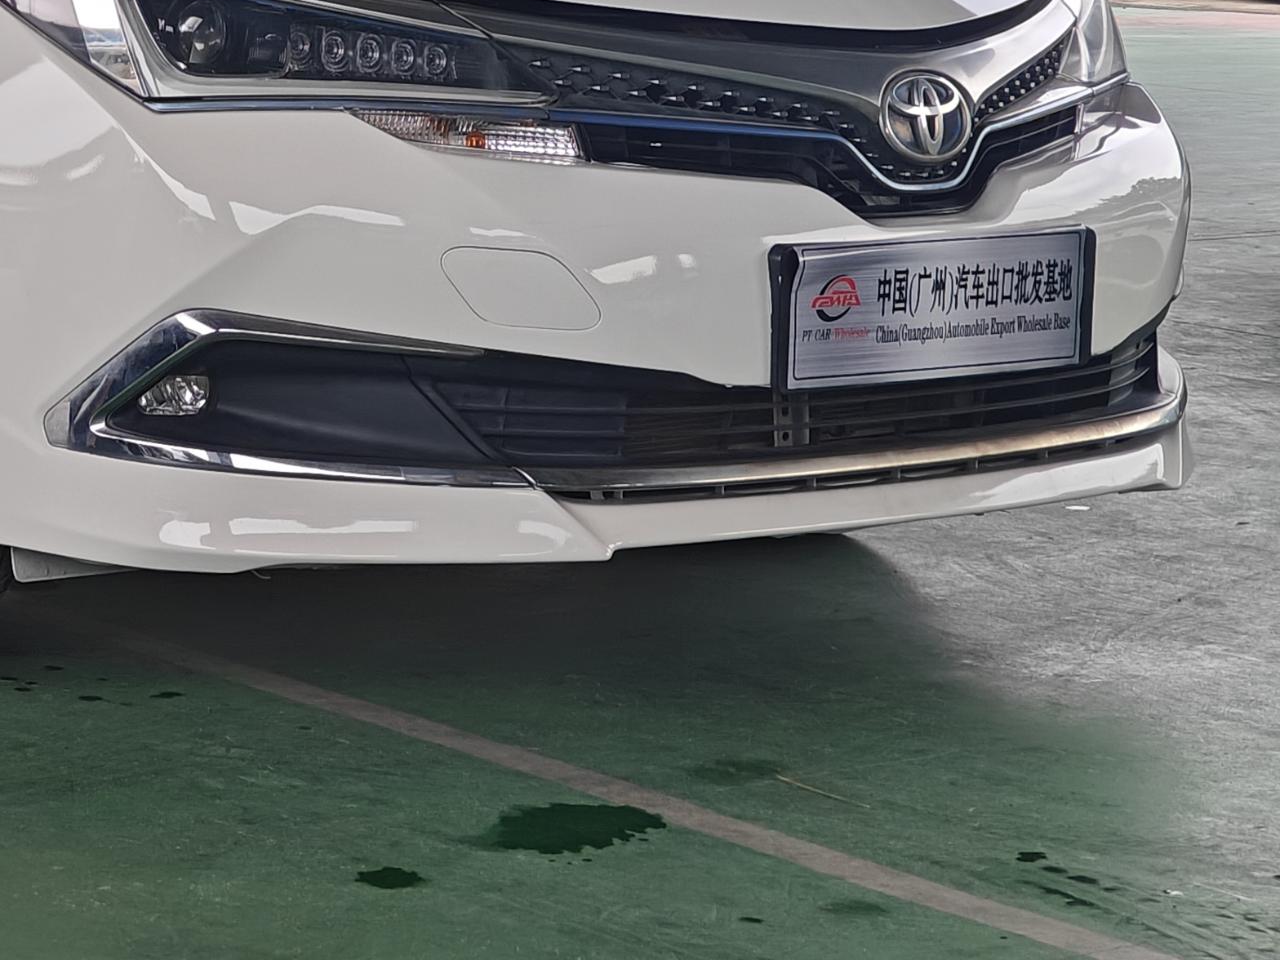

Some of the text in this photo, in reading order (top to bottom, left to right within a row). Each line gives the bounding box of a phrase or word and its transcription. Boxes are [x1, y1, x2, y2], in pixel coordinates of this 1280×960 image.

[990, 316, 1016, 338] Export
[1017, 313, 1052, 333] Wholesale
[1053, 311, 1070, 330] Base
